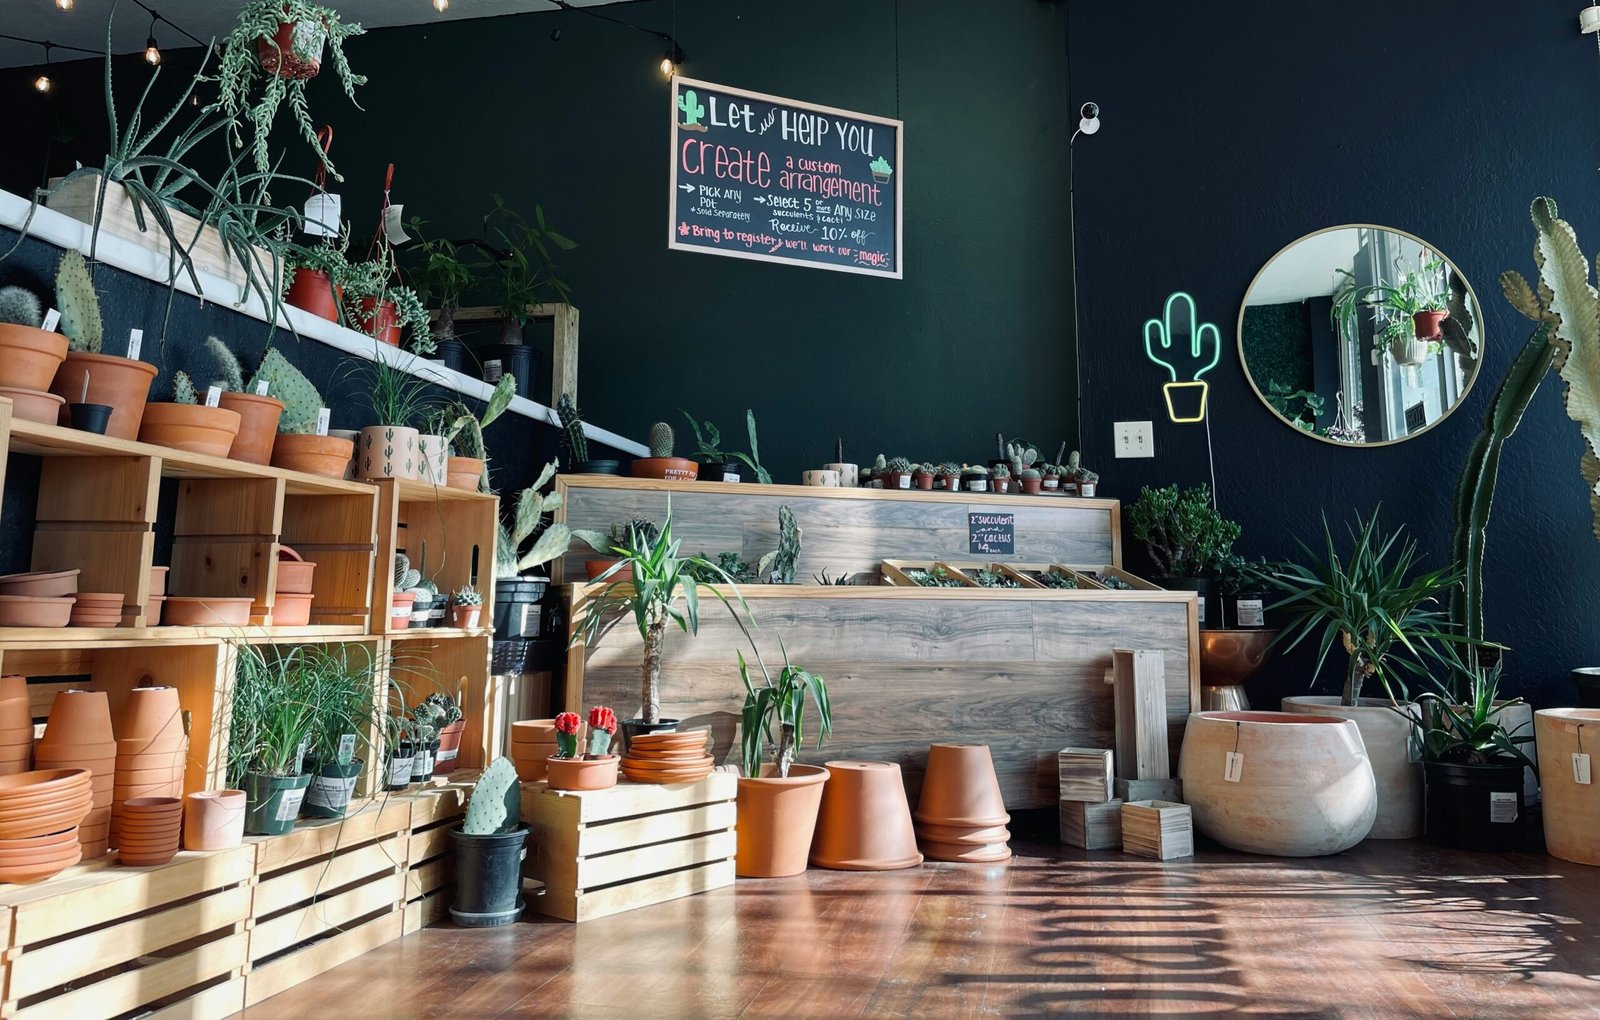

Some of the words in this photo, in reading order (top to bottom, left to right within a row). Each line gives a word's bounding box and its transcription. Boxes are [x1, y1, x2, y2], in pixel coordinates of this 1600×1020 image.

[709, 96, 756, 133] Let
[786, 155, 794, 170] a
[798, 158, 842, 176] custom
[766, 194, 800, 209] Select
[803, 198, 812, 212] 5
[779, 170, 883, 207] arrangement
[691, 224, 720, 243] Bring
[722, 228, 735, 240] to
[736, 232, 777, 248] register
[812, 242, 835, 254] work
[838, 246, 852, 256] our
[859, 250, 886, 266] magic
[768, 218, 818, 235] Receive
[821, 226, 848, 241] 10%
[850, 229, 876, 246] off
